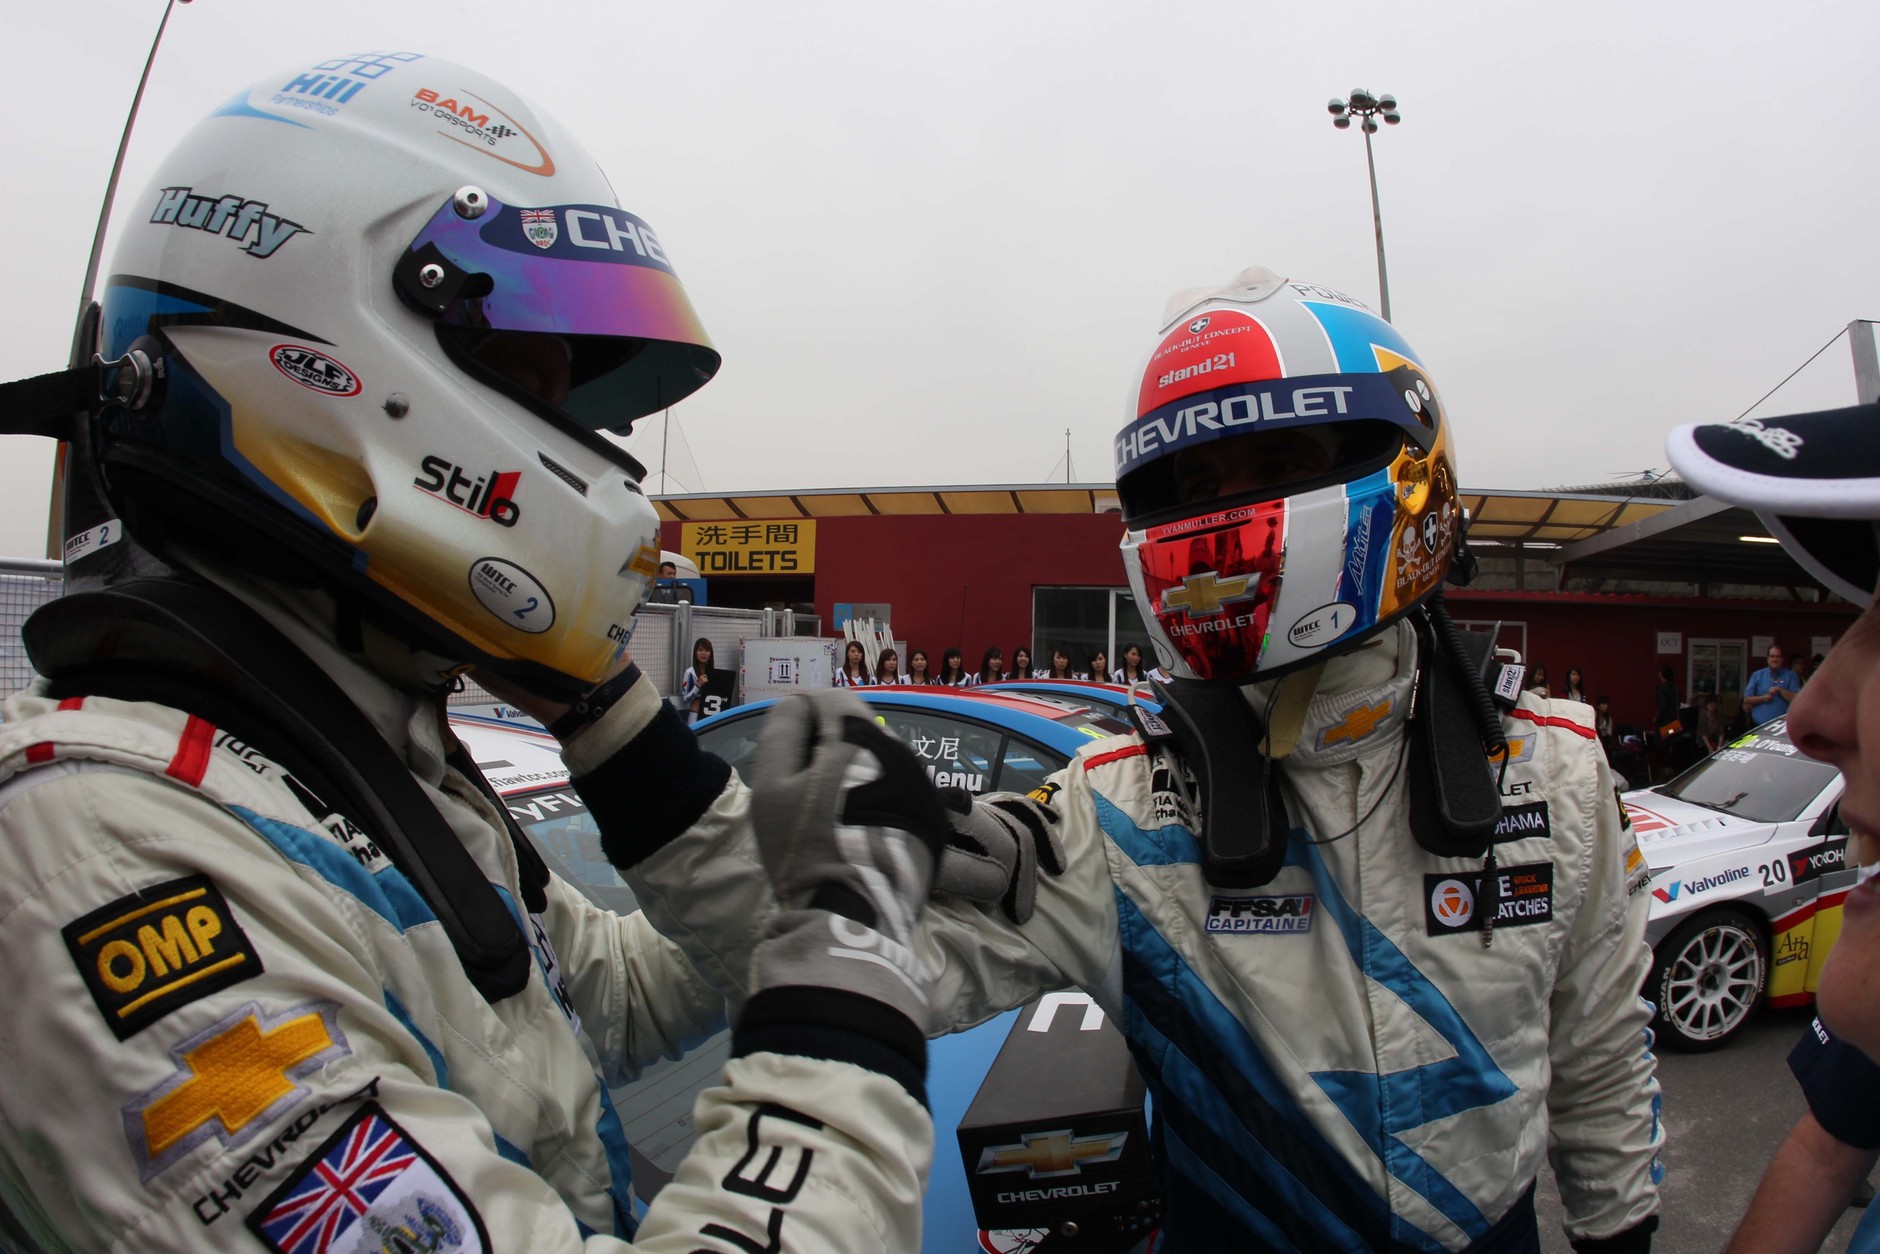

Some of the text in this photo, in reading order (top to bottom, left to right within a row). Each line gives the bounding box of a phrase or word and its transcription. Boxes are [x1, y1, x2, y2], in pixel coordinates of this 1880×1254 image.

[282, 73, 367, 104] Hill
[270, 93, 339, 117] Partnerships
[414, 88, 489, 128] BAM
[149, 186, 314, 259] Huffy
[1204, 326, 1252, 341] CONCEPT
[284, 361, 342, 390] DESIGNS
[1114, 386, 1353, 470] CHEVROLET
[414, 455, 521, 527] Stilo
[1162, 508, 1257, 537] YVANMULLER.COM
[100, 526, 110, 546] 2
[696, 524, 799, 546] 洗手間
[695, 551, 798, 571] TOILETS
[481, 563, 517, 594] WTCC
[513, 597, 538, 620] 2
[1170, 613, 1257, 637] CHEVROLET
[1331, 610, 1338, 629] 1
[1661, 638, 1679, 648] OUT
[703, 695, 721, 716] 3
[912, 735, 960, 760] 文尼
[1808, 849, 1844, 869] YOKOH
[1684, 866, 1749, 895] Valvoline
[1758, 859, 1786, 888] 20
[1211, 899, 1301, 917] FFSA
[1493, 897, 1548, 920] ATCHES
[1209, 918, 1308, 930] CAPITAINE
[97, 905, 223, 994] OMP
[1660, 967, 1671, 1022] ADVAN
[997, 1181, 1121, 1204] CHEVROLET
